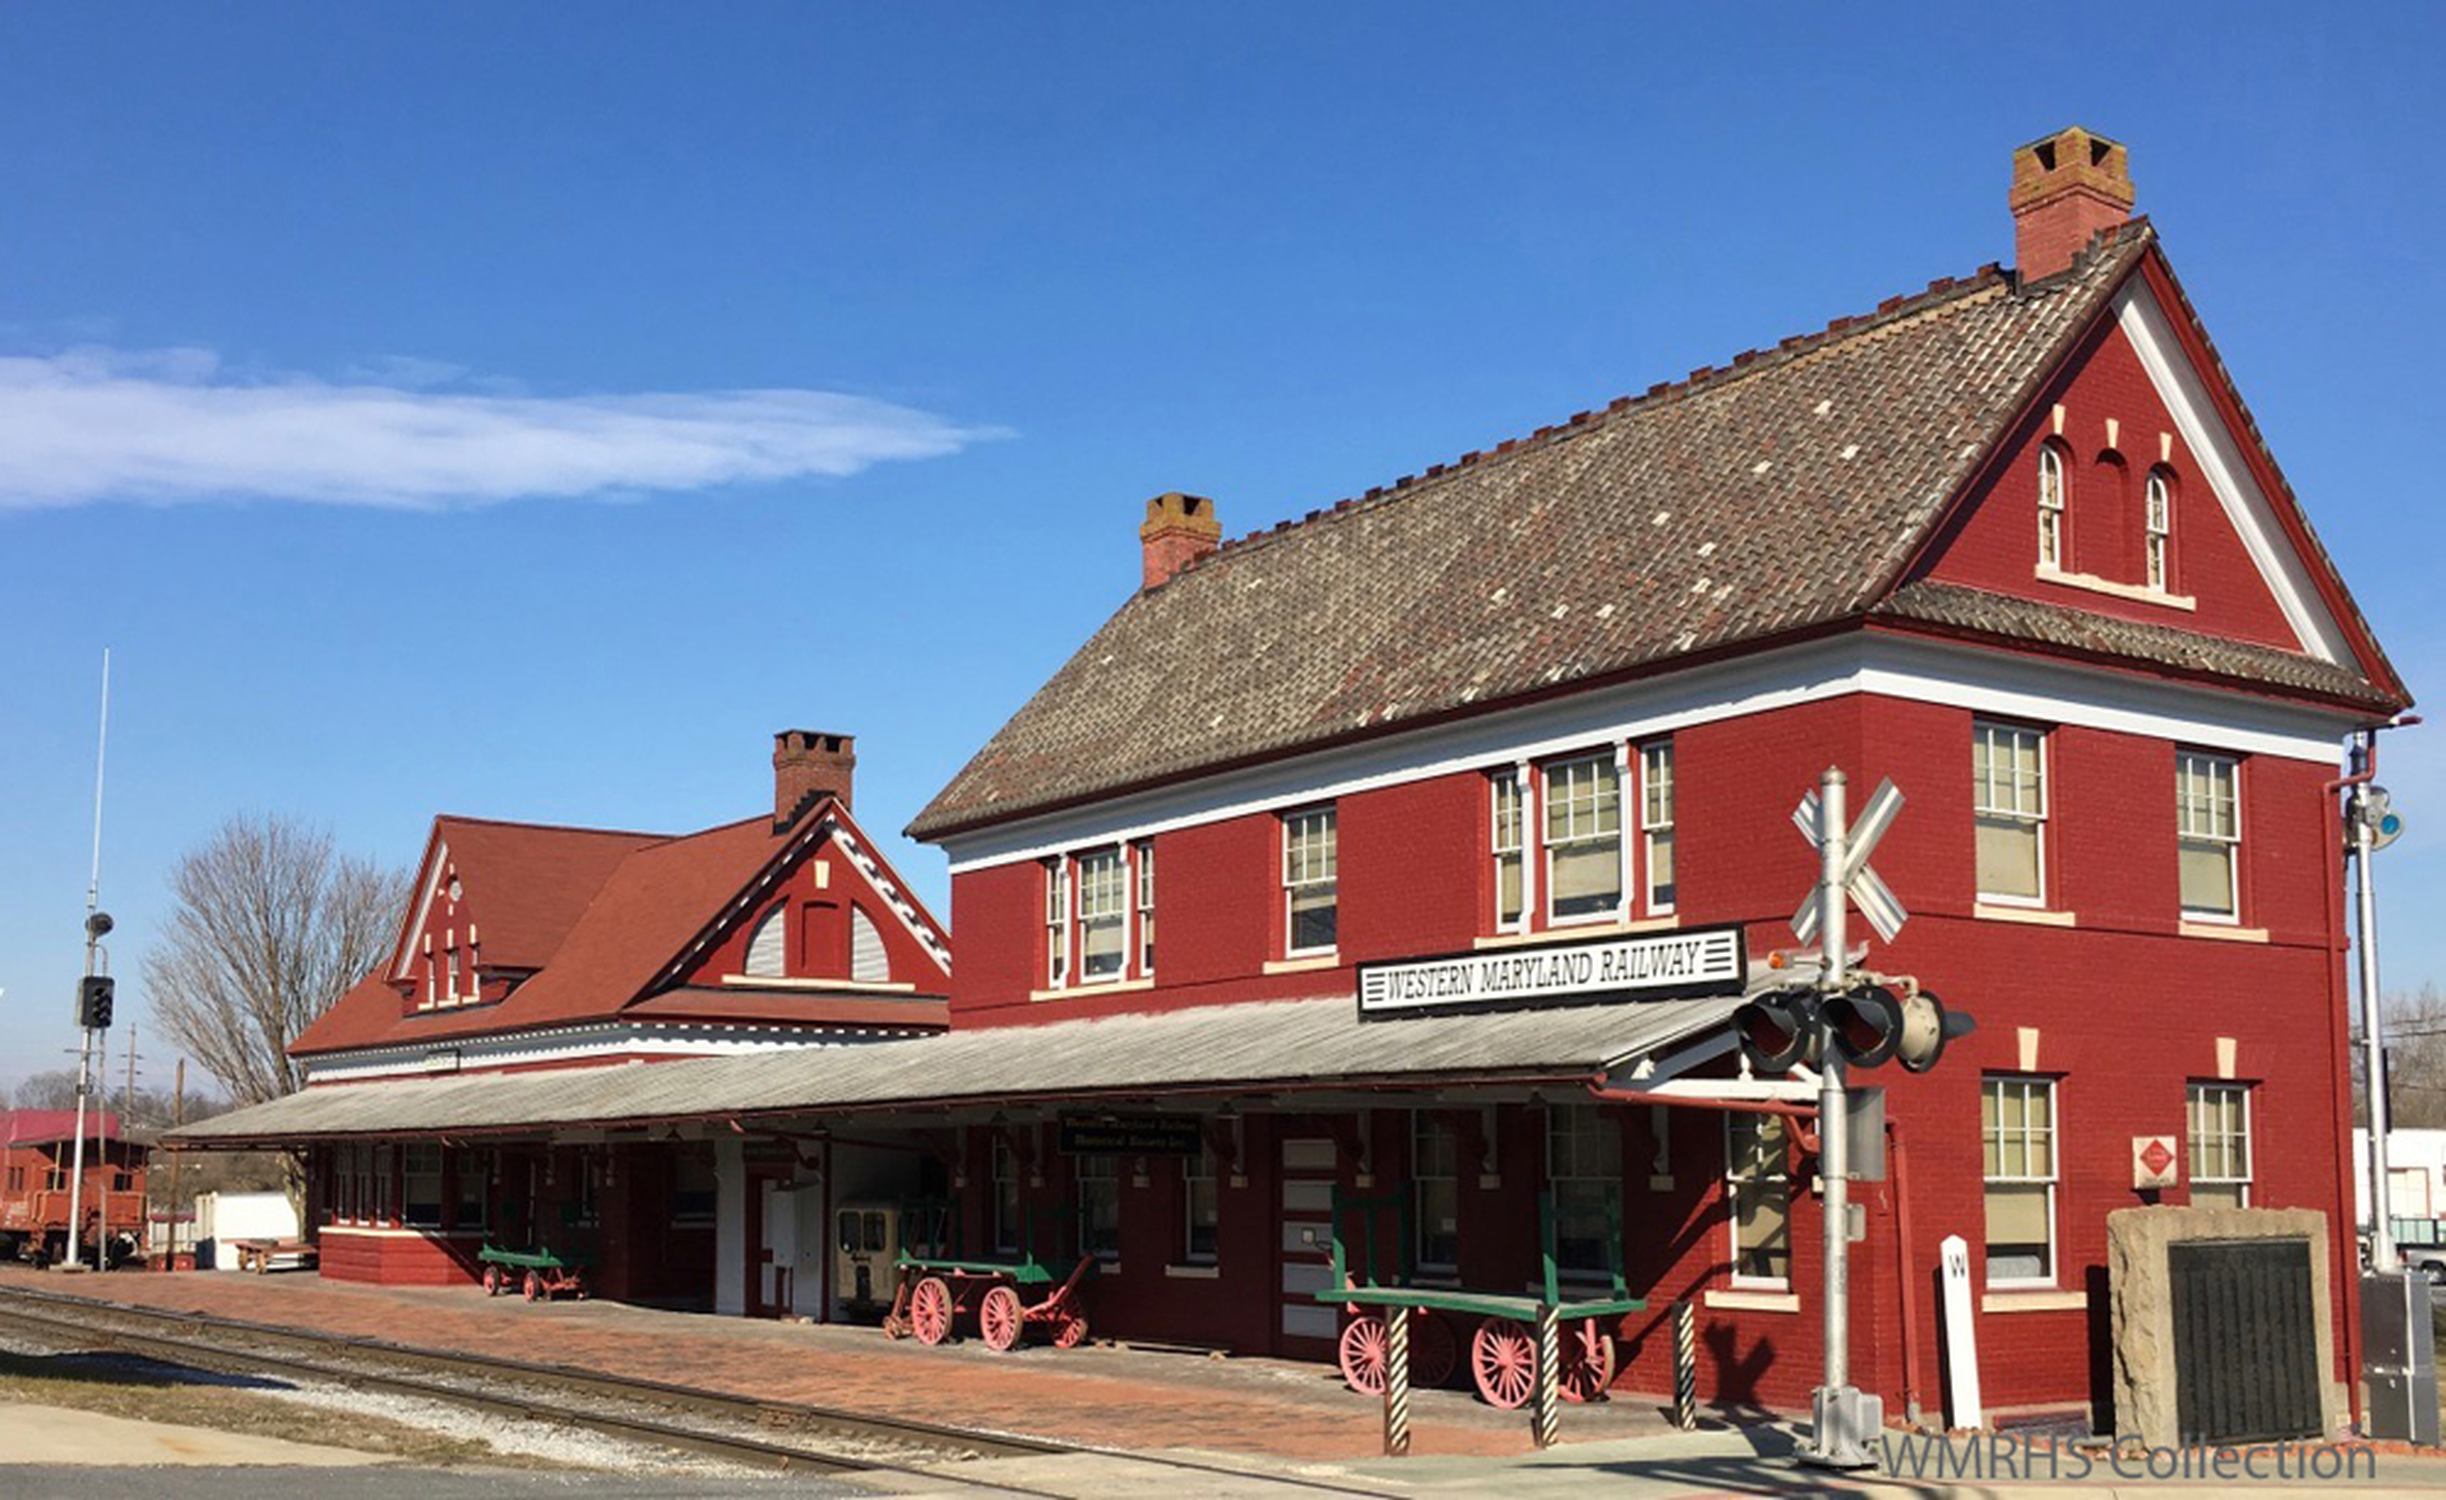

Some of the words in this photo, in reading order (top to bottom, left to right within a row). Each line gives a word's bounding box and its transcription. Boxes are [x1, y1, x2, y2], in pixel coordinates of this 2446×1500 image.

[1389, 963, 1474, 998] WESTERN
[1481, 952, 1593, 993] MARYLAND
[1601, 941, 1701, 981] RAILWAY
[1949, 1254, 1966, 1278] W
